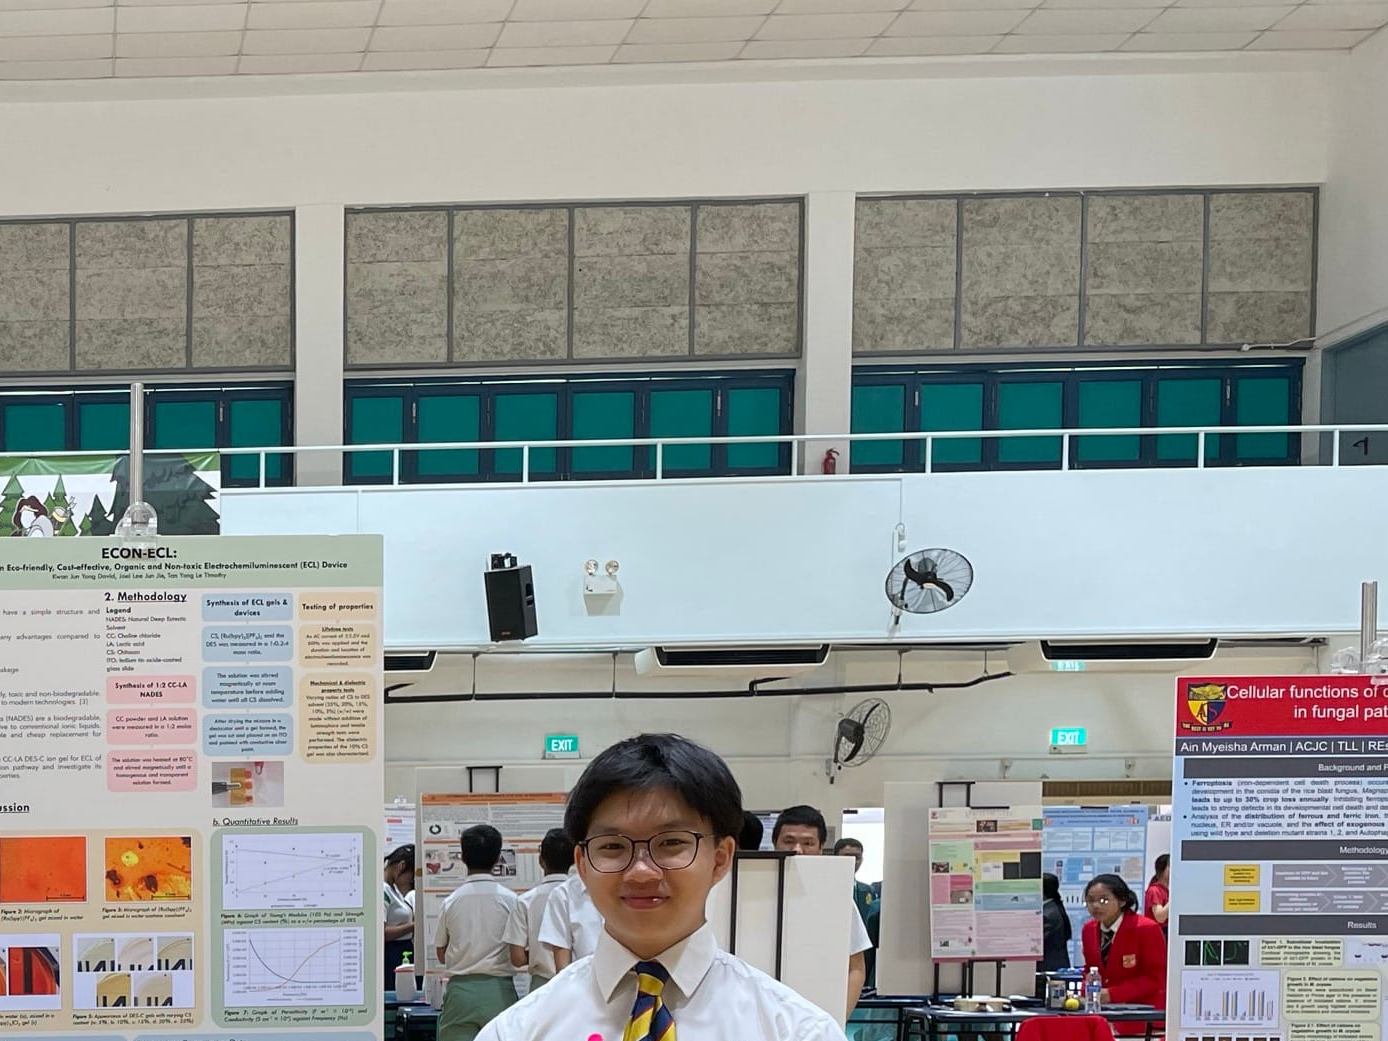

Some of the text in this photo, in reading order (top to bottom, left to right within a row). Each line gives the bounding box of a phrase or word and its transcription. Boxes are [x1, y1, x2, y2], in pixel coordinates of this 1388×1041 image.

[100, 547, 178, 559] ECON-ECL:
[6, 563, 54, 572] Eco-friendly,
[56, 563, 112, 571] Cost-effective,
[113, 562, 145, 571] Organic
[203, 561, 298, 569] Electrochemiluminescent
[300, 561, 319, 569] (ECL)
[203, 571, 226, 579] Timothy
[104, 591, 187, 603] 2. Methodology
[206, 599, 239, 607] Synthesis
[265, 598, 280, 606] gels
[301, 603, 326, 611] Testing
[338, 603, 373, 611] properties
[105, 606, 132, 614] Legend
[1226, 685, 1378, 698] Cellular functions of
[1294, 705, 1388, 720] in fungal pat
[1058, 730, 1078, 744] EXIT
[552, 740, 573, 751] EXIT
[1180, 741, 1286, 753] Ain Myeisha Arman
[1294, 741, 1328, 751] ACJC
[1337, 741, 1359, 751] TLL
[1317, 763, 1364, 772] Background
[212, 816, 298, 826] b. Quantitative Results
[1338, 845, 1388, 855] Methodology
